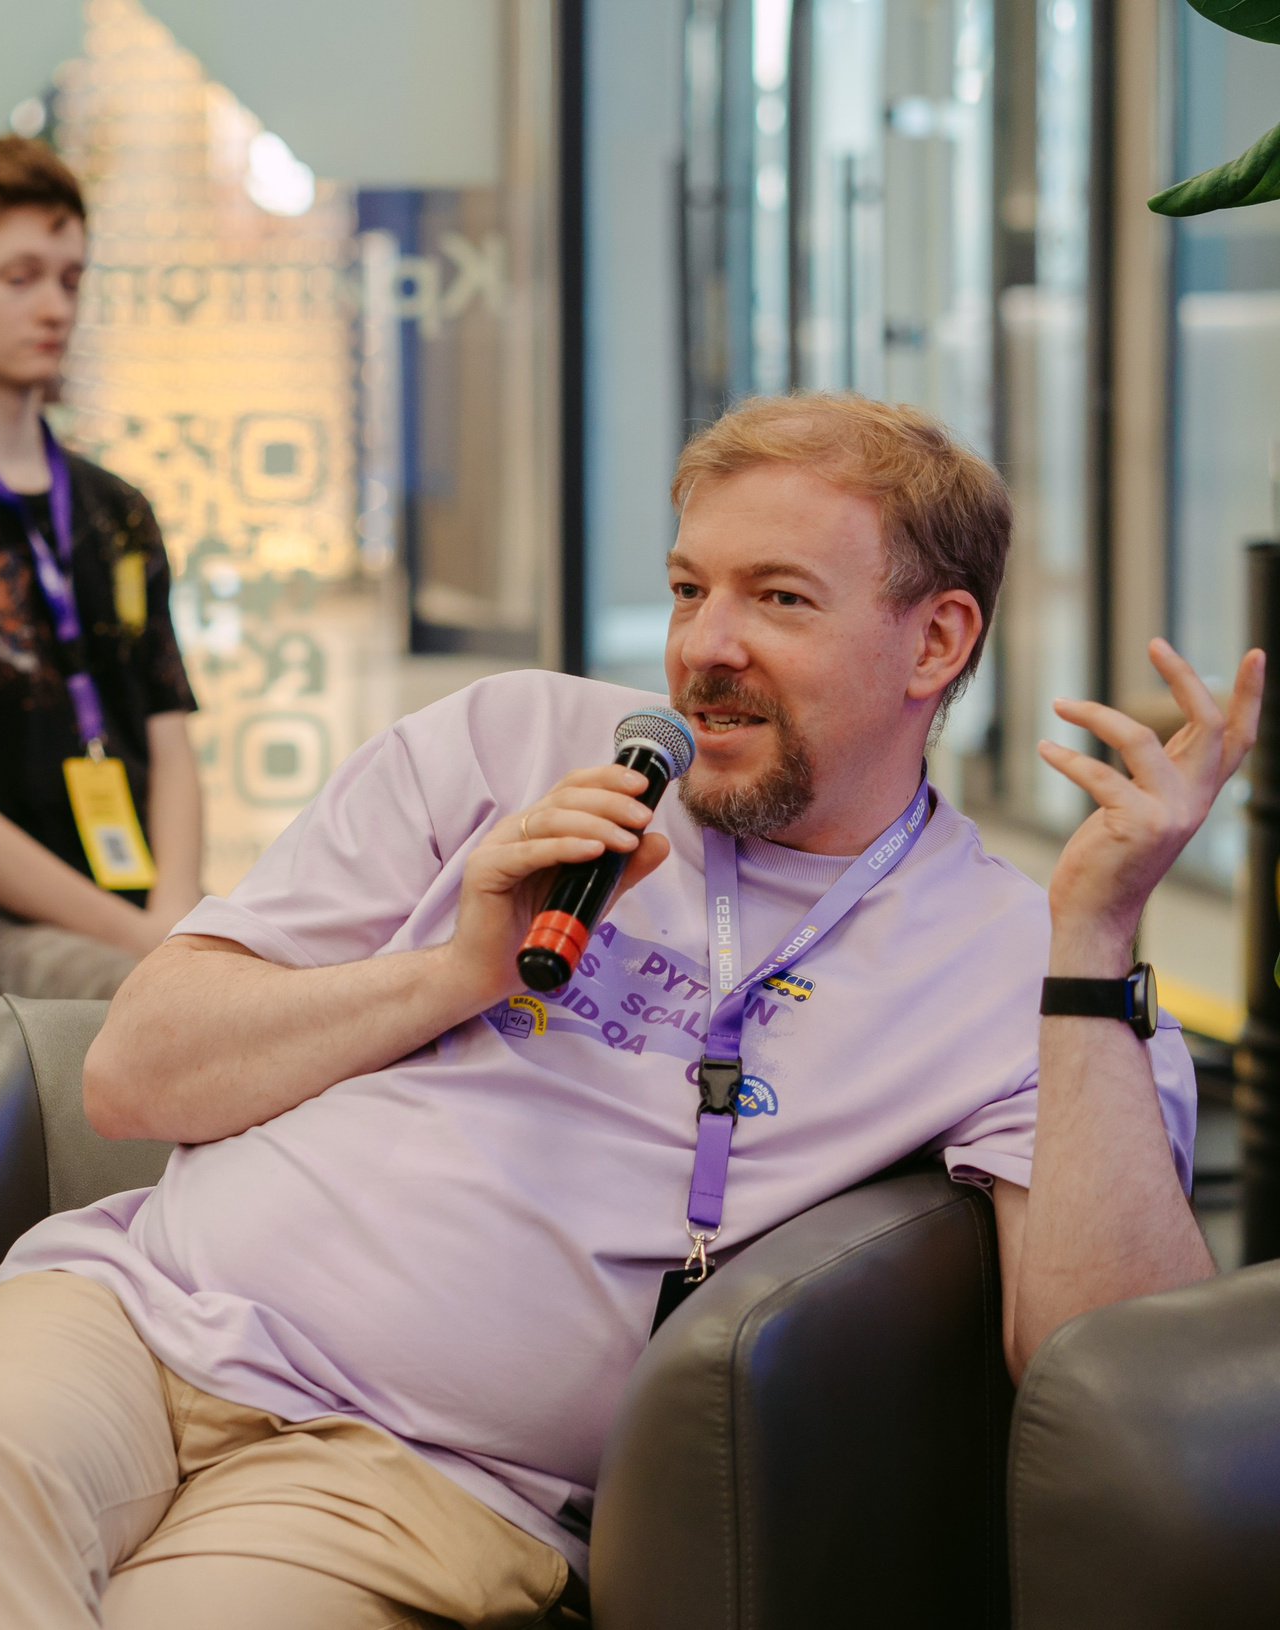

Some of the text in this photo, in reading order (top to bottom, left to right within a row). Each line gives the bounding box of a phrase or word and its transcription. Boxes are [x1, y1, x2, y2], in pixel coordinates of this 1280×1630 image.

[715, 896, 732, 945] сезон
[638, 951, 779, 1027] PYTN
[513, 997, 545, 1032] BREAK POINT
[620, 992, 708, 1044] SCAL
[601, 1020, 648, 1057] QA
[751, 1087, 766, 1102] КОД
